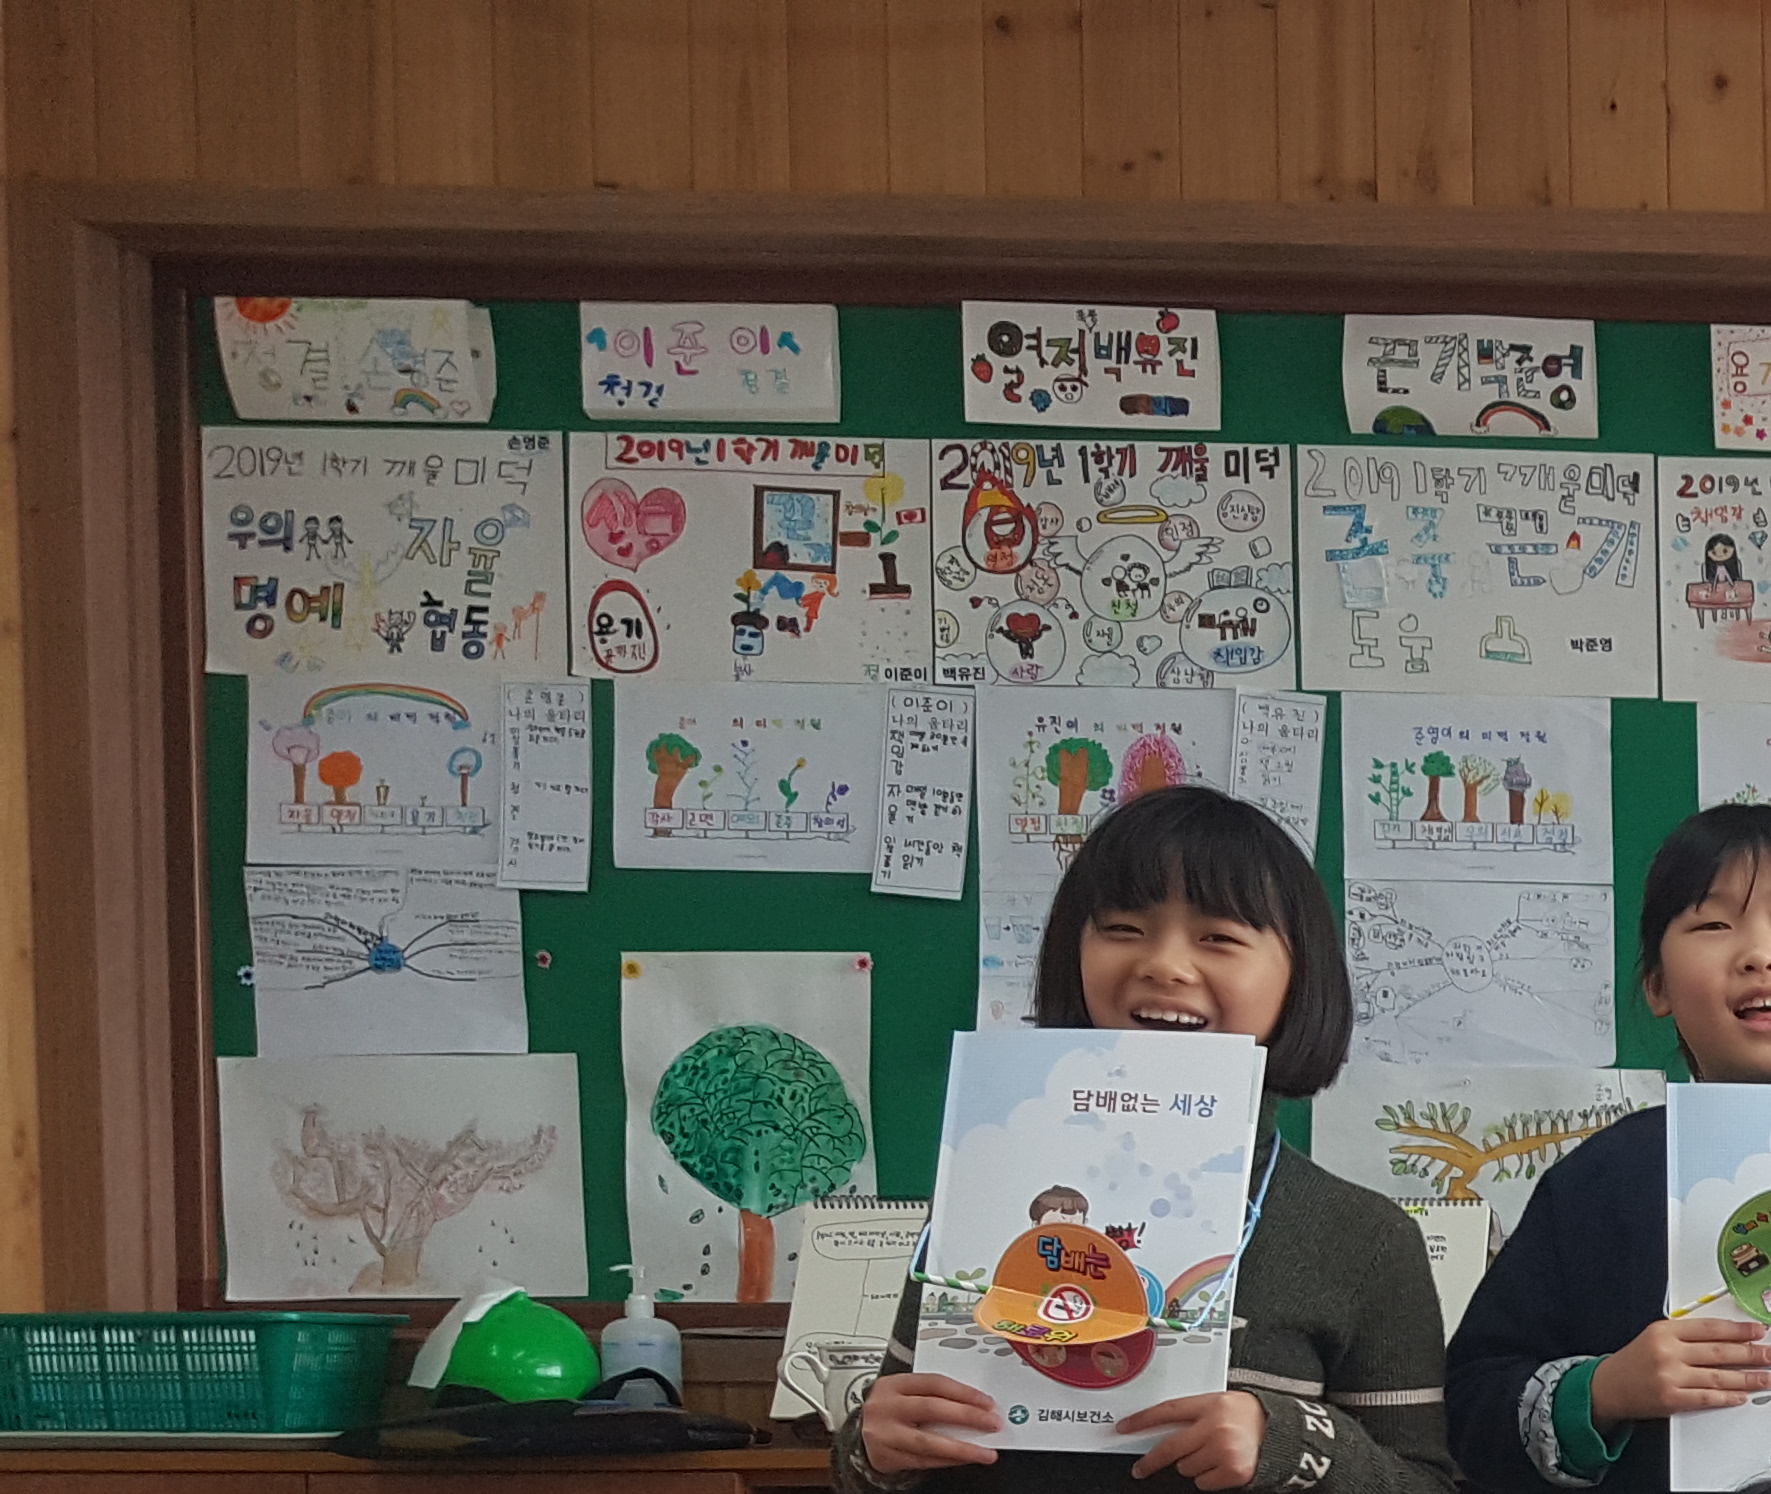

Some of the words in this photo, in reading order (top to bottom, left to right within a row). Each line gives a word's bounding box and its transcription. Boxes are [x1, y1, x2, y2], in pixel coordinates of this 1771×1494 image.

[228, 510, 295, 553] 우의
[233, 574, 344, 640] 명예
[884, 666, 927, 681] 이준이
[942, 666, 986, 681] 백유진
[1072, 1089, 1161, 1117] 담배없는
[1170, 1093, 1217, 1118] 세상
[1037, 1235, 1111, 1279] 담배는
[1037, 1408, 1115, 1427] 김해시보건소
